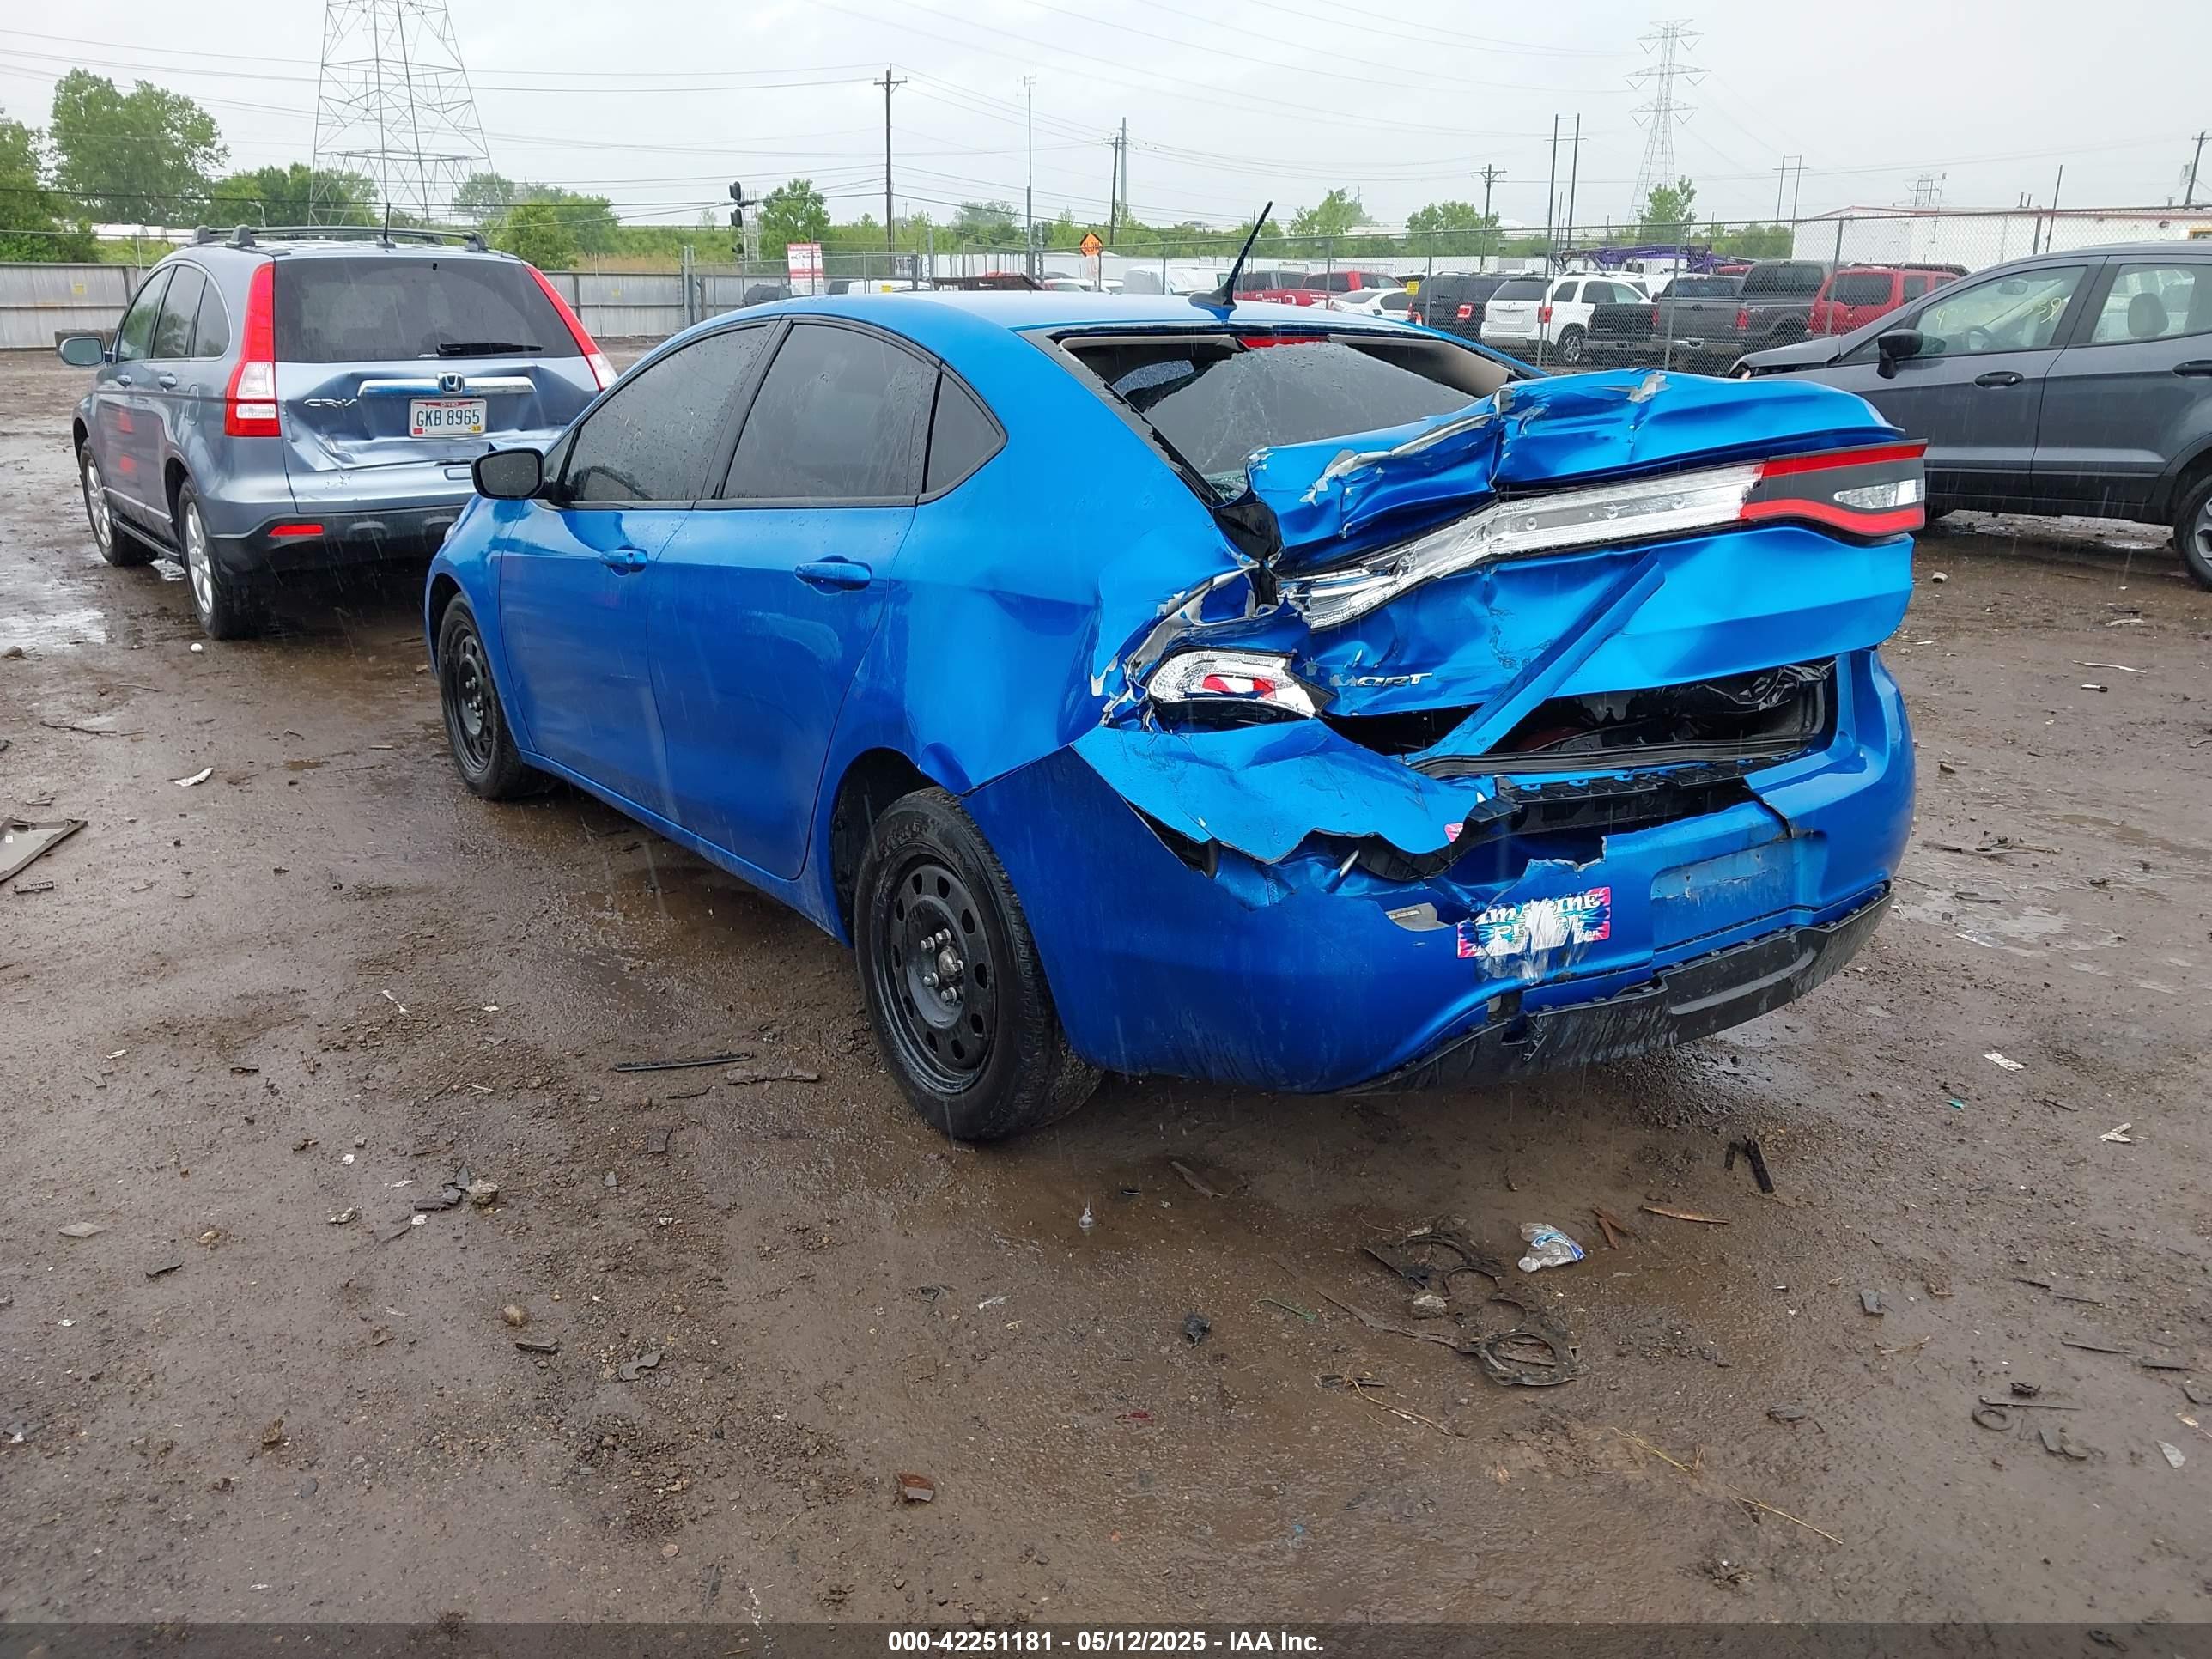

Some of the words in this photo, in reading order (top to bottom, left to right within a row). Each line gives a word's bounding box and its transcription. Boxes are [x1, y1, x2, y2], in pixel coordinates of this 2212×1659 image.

[304, 398, 357, 407] CR-V
[416, 410, 442, 427] GKB
[447, 408, 480, 426] 8965
